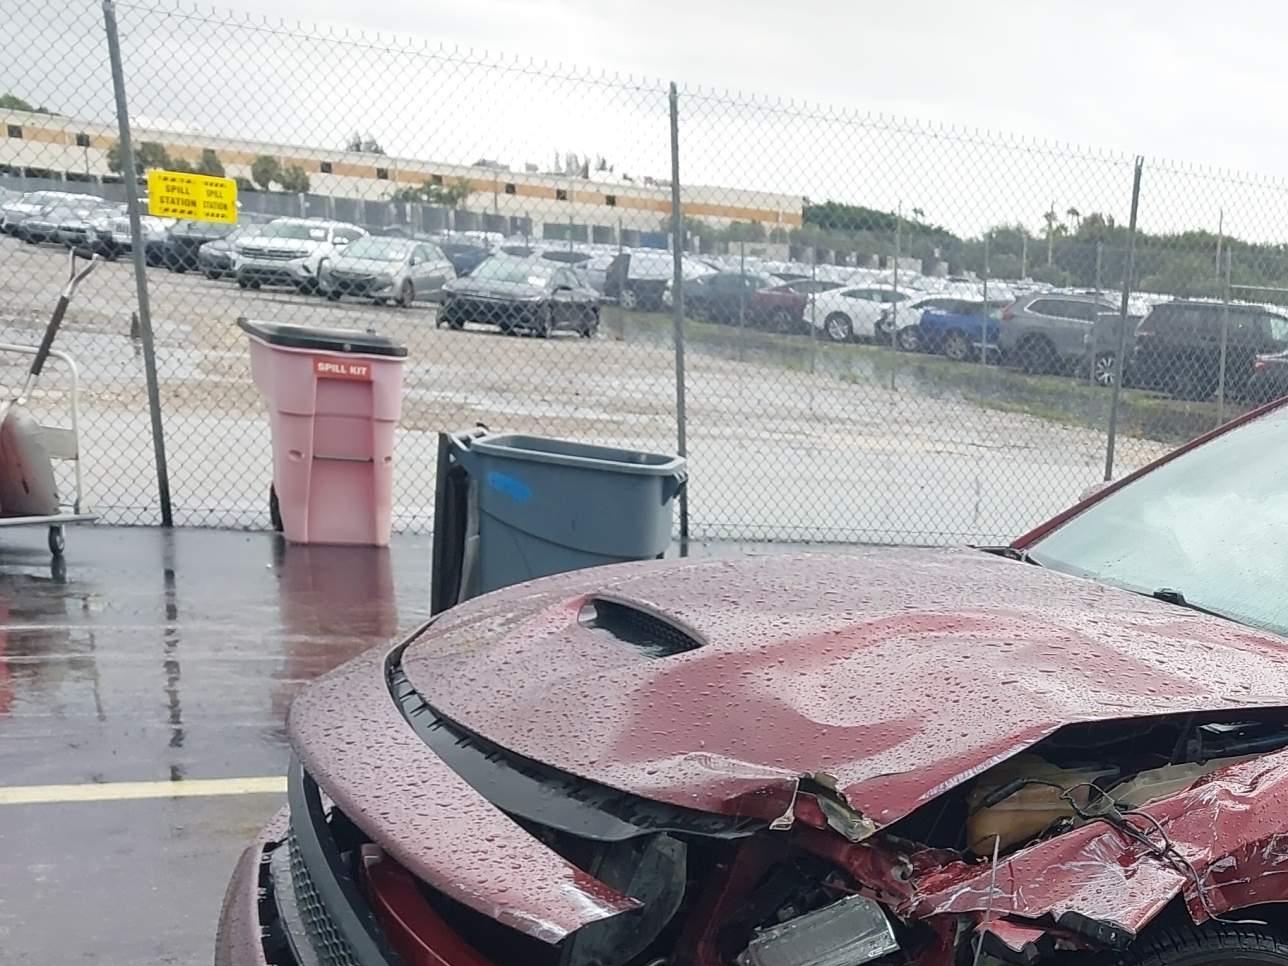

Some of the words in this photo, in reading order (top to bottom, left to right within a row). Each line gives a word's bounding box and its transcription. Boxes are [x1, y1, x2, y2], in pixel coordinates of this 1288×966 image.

[166, 185, 190, 195] SPILL
[206, 189, 223, 199] SPILL
[160, 196, 197, 208] STATION
[203, 201, 228, 211] STATION
[318, 362, 347, 374] SPILL
[350, 365, 367, 376] KIT
